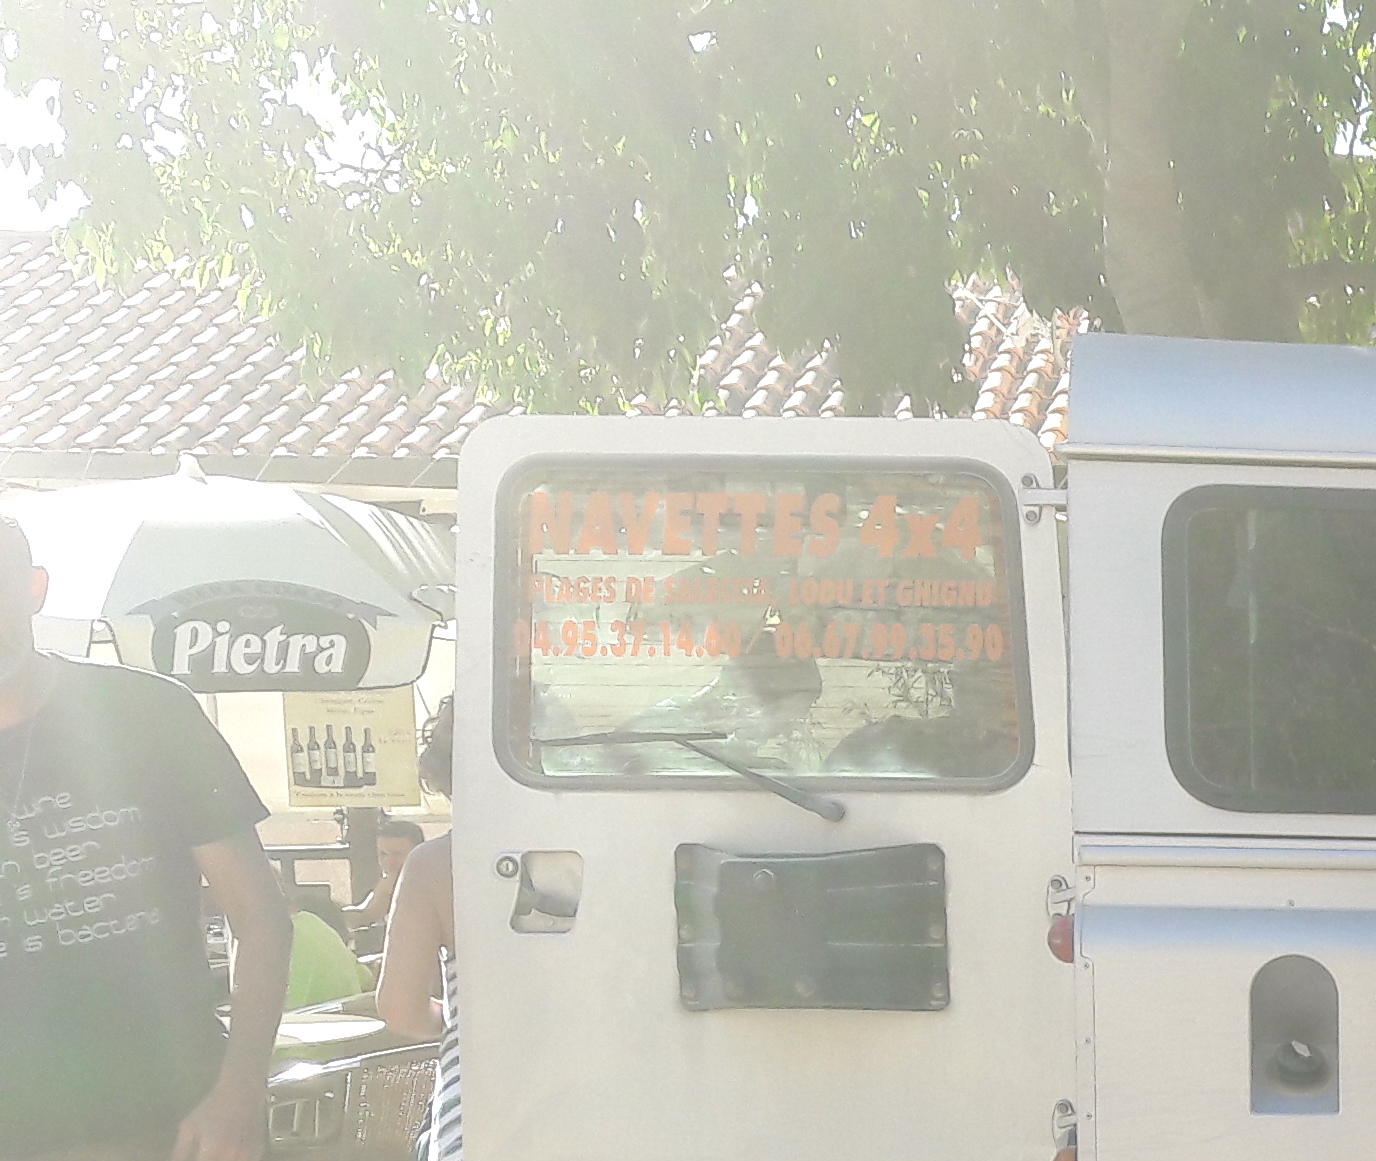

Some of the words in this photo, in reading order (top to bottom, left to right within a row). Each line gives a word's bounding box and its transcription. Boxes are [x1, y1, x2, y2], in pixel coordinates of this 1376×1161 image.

[530, 491, 842, 557] NAVETTES
[859, 494, 983, 559] 4x4
[528, 576, 617, 603] PLAGES
[625, 576, 655, 603] DE
[862, 579, 888, 605] ET
[171, 619, 348, 675] Pietra
[513, 619, 742, 658] 04.95.37.14.60
[774, 621, 1004, 660] 06.67.99.35.90
[32, 840, 101, 869] beer
[24, 891, 117, 926] water
